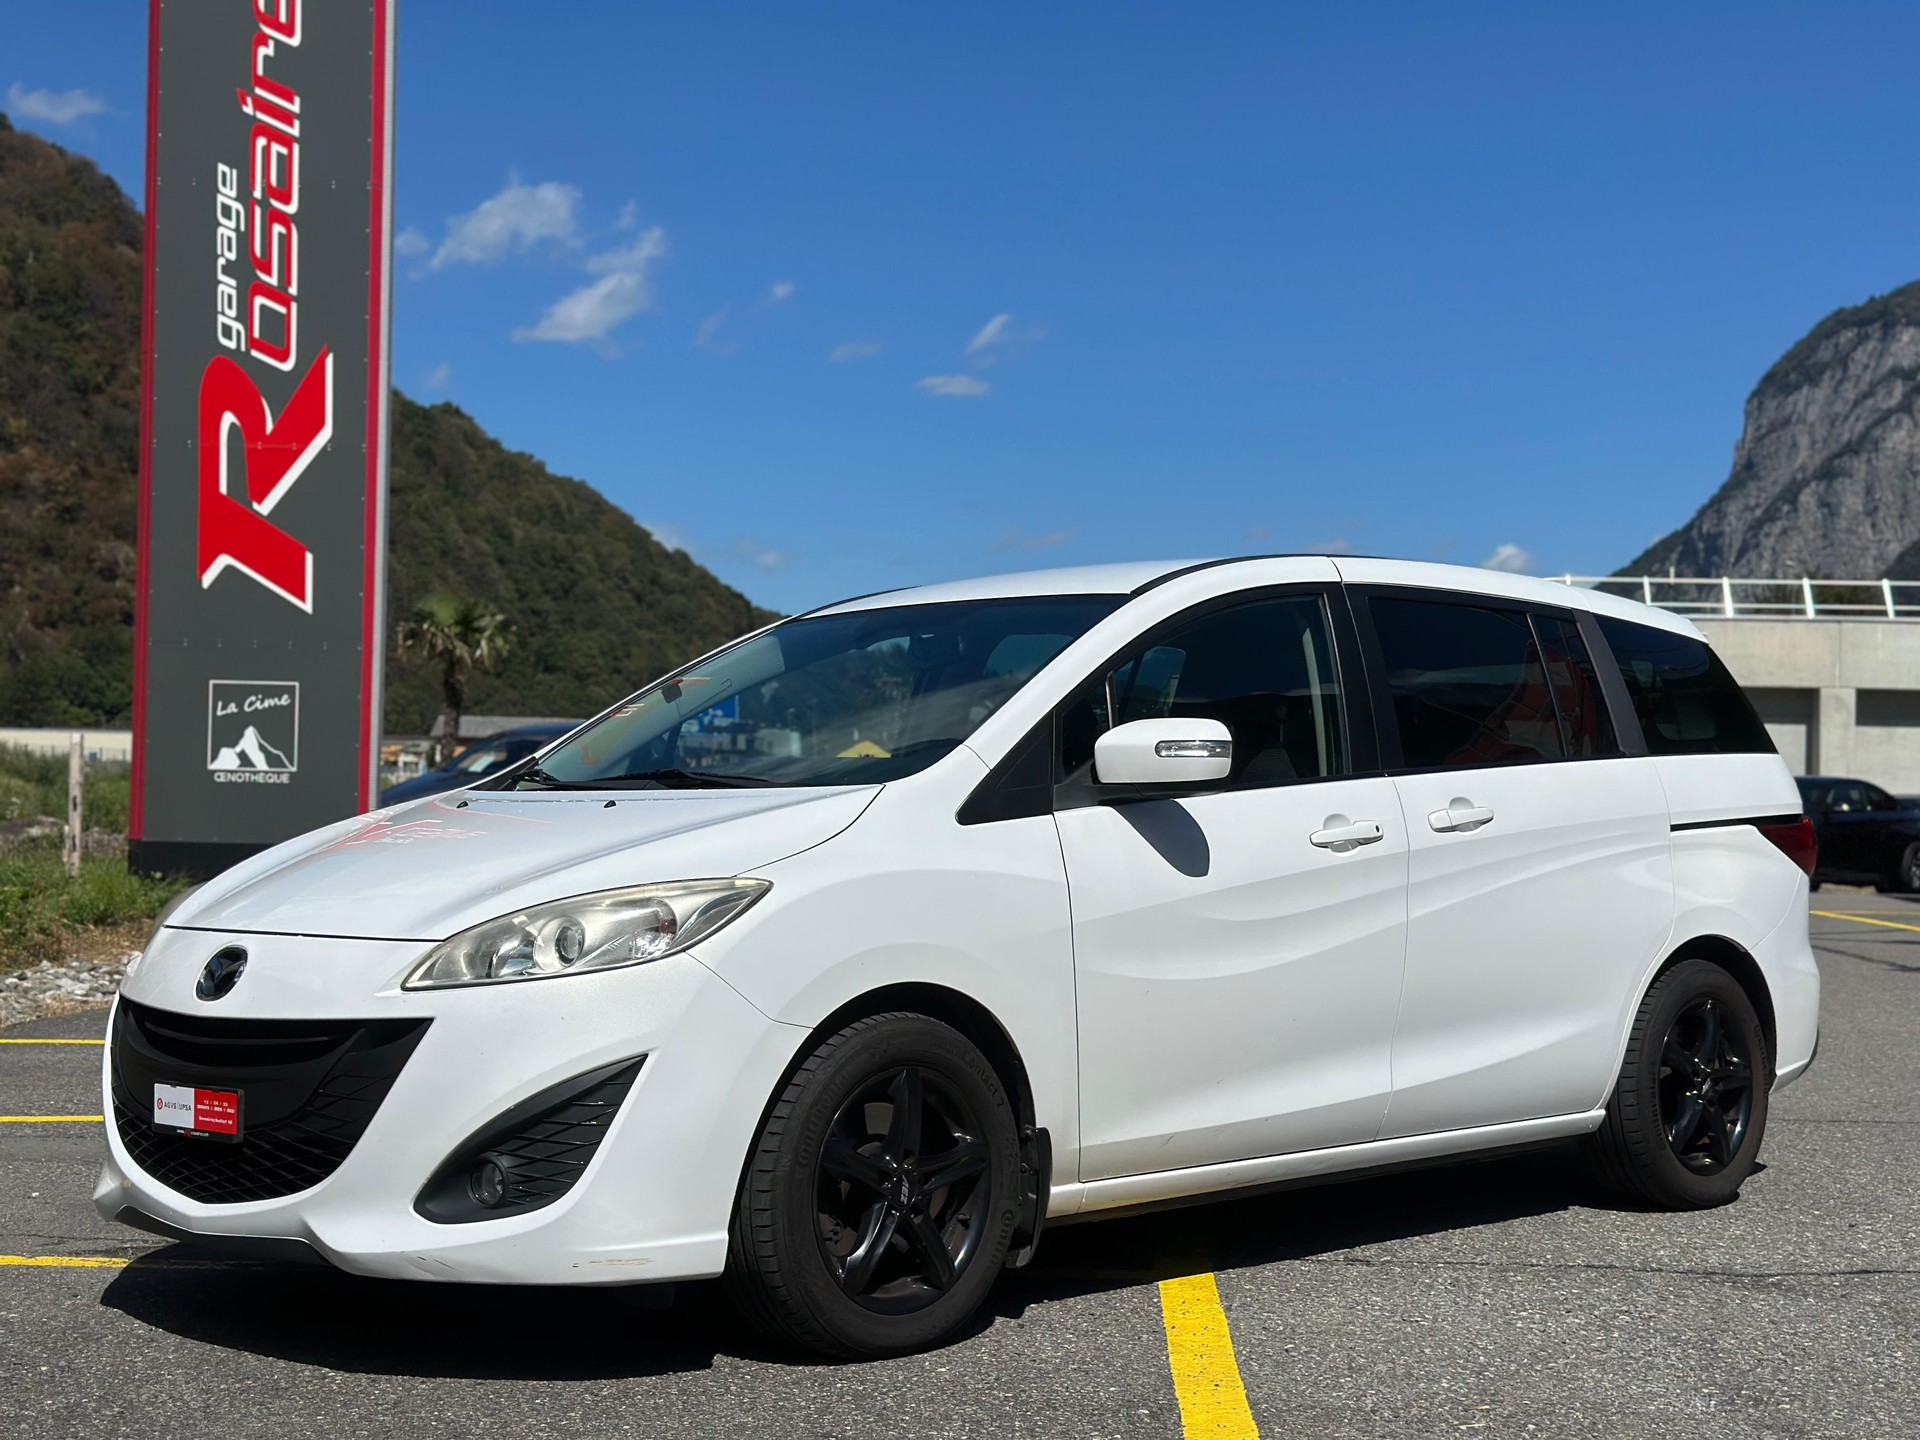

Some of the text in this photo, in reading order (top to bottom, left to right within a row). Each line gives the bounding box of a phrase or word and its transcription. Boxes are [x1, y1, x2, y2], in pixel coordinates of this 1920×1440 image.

[217, 163, 245, 350] garage
[215, 693, 291, 717] La Cime
